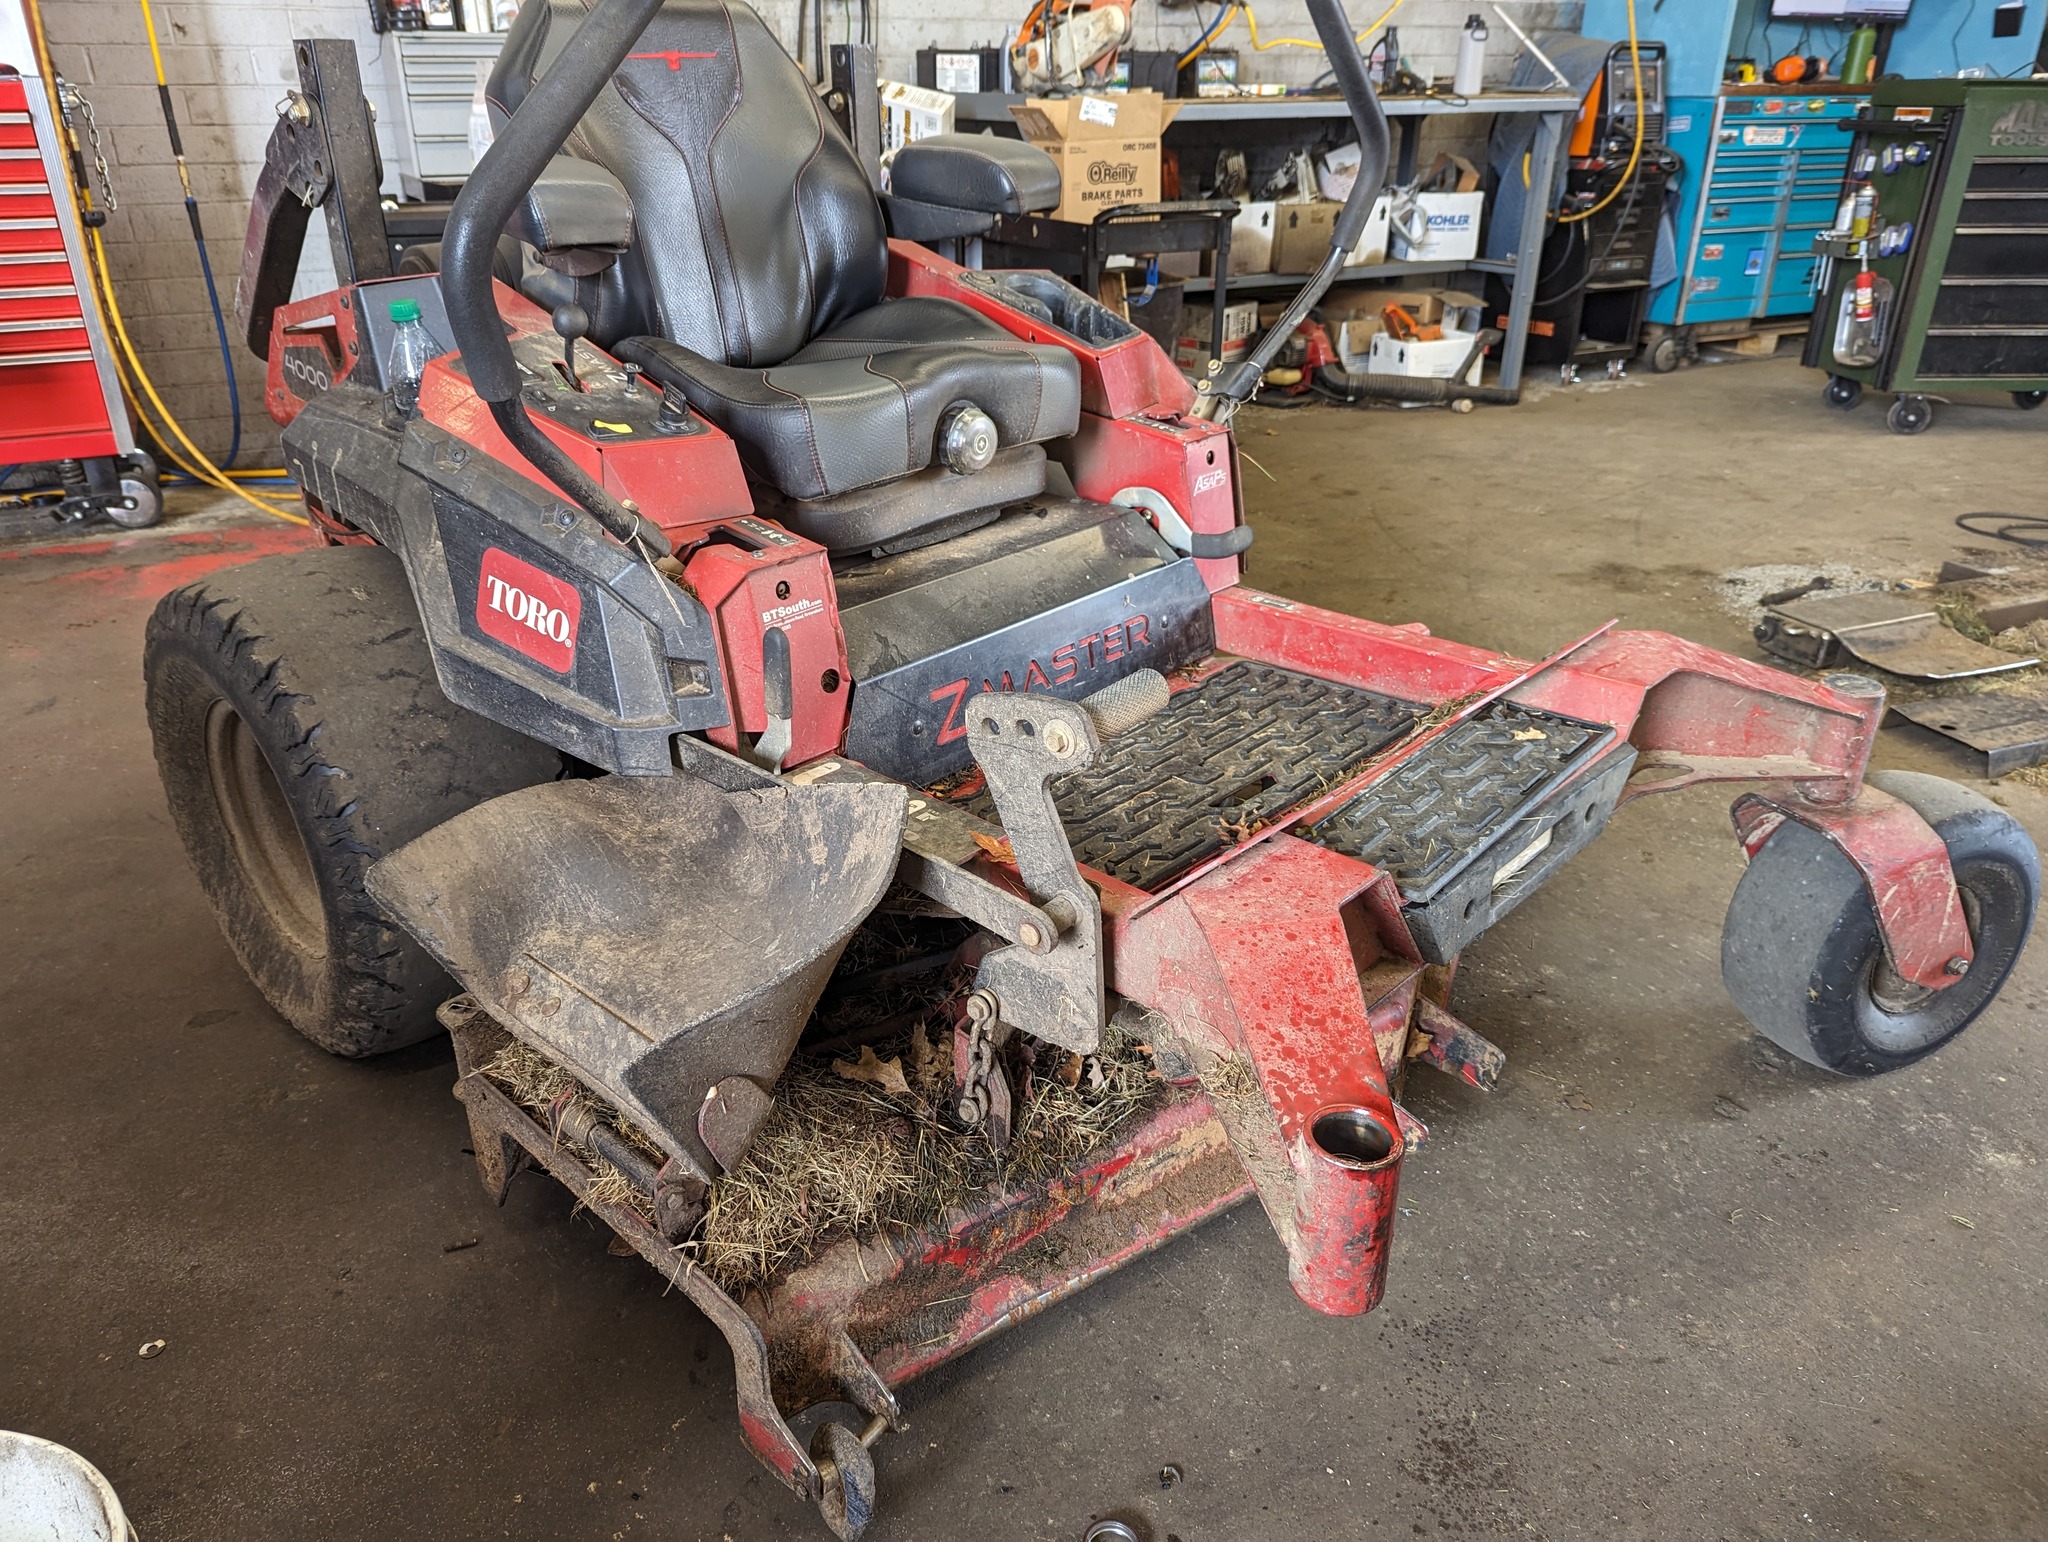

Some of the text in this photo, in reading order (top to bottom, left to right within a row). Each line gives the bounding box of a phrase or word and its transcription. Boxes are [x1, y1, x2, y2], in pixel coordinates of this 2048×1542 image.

[1087, 161, 1138, 185] O'Reilly
[1081, 188, 1143, 201] BRAKE PARTS
[1426, 214, 1470, 226] KOHLER
[285, 353, 328, 391] 4000
[487, 574, 571, 643] TORO
[761, 598, 823, 623] BTSouth.com
[929, 676, 970, 747] Z
